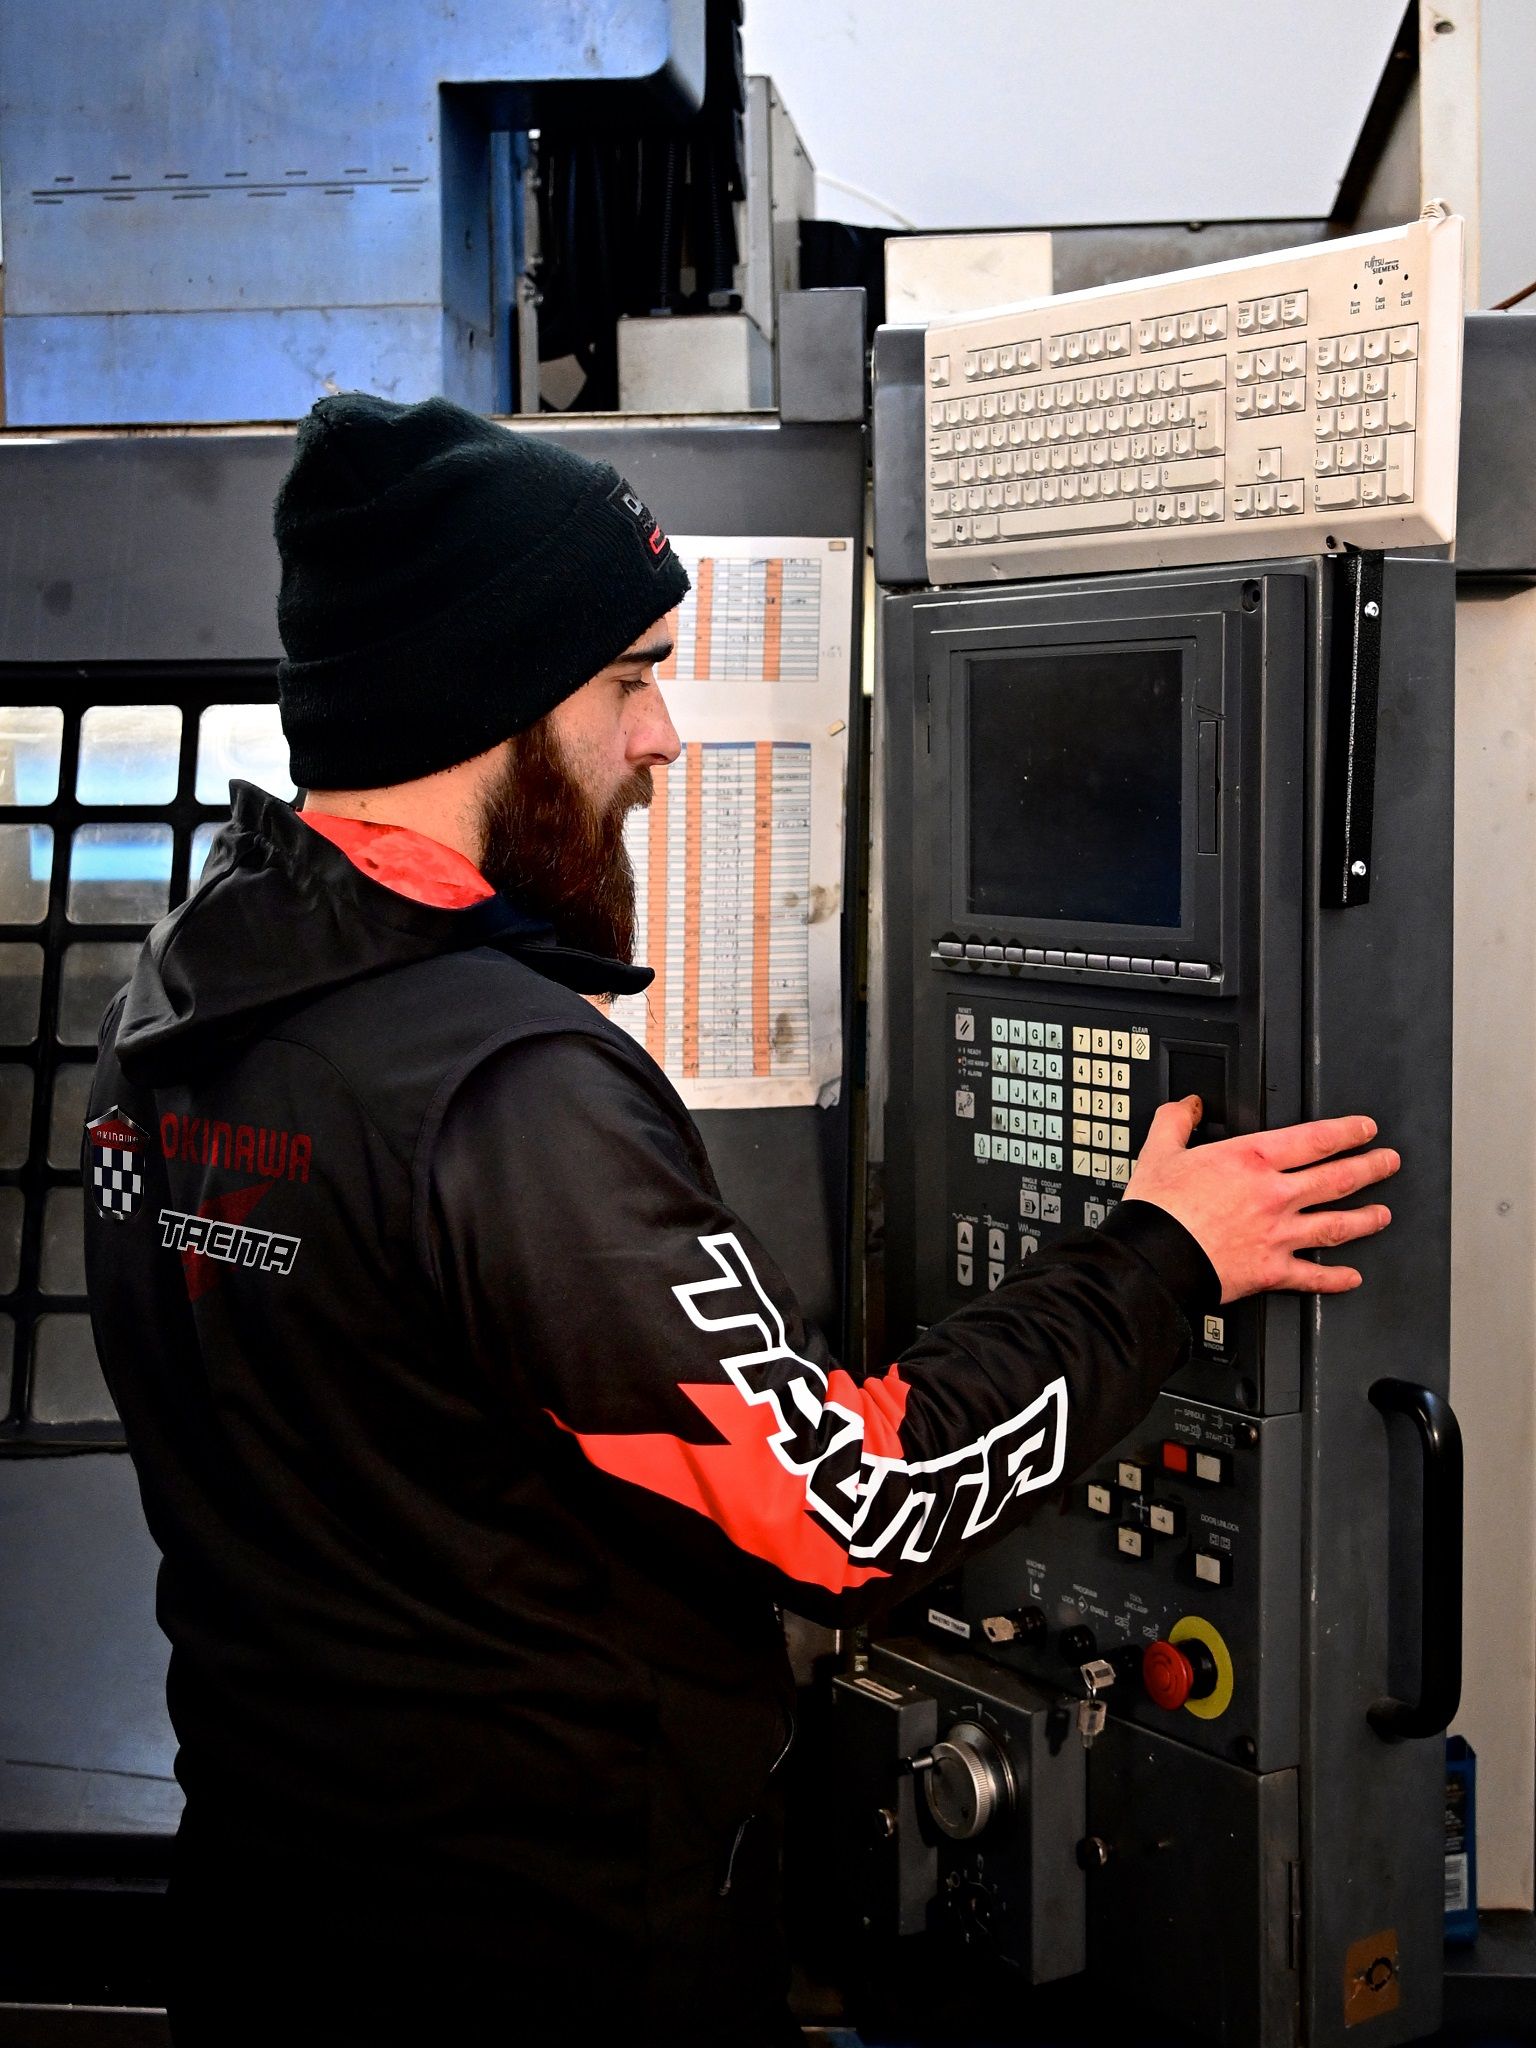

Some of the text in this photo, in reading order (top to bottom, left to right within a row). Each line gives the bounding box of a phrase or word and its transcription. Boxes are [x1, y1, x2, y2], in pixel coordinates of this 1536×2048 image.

[1365, 256, 1384, 269] FUJITSU
[1373, 264, 1399, 274] SIEMENS
[1401, 291, 1412, 299] Scroll
[1317, 380, 1321, 388] 7
[1342, 377, 1346, 385] 8
[1109, 410, 1114, 418] O
[1083, 476, 1089, 484] M
[997, 1025, 1002, 1035] O
[1014, 1027, 1020, 1037] N
[1032, 1029, 1038, 1039] G
[1051, 1031, 1056, 1041] P
[1079, 1035, 1083, 1045] 7
[1098, 1037, 1103, 1047] 8
[1117, 1039, 1123, 1050] 9
[997, 1055, 1002, 1065] X
[1014, 1057, 1020, 1067] Y
[1033, 1060, 1038, 1070] Z
[1051, 1062, 1057, 1072] Q
[1079, 1066, 1083, 1076] 4
[1098, 1068, 1103, 1078] 5
[1118, 1070, 1123, 1081] 6
[999, 1085, 1000, 1094] I
[1015, 1088, 1019, 1097] J
[1033, 1090, 1038, 1100] K
[1051, 1093, 1057, 1103] R
[1079, 1097, 1082, 1106] 1
[1098, 1099, 1103, 1110] 2
[1118, 1102, 1122, 1112] 3
[996, 1114, 1002, 1124] M
[1014, 1117, 1020, 1127] S
[1033, 1120, 1038, 1130] T
[1052, 1123, 1056, 1133] L
[1098, 1130, 1103, 1140] 0
[160, 1111, 313, 1184] OKINAWA
[997, 1144, 1002, 1153] F
[1015, 1147, 1020, 1157] D
[1033, 1150, 1038, 1160] H
[1051, 1153, 1056, 1163] B
[1041, 1179, 1062, 1189] COOLANT
[158, 1208, 302, 1275] TACITA
[1184, 1409, 1206, 1421] SPINDLE
[1175, 1423, 1190, 1432] STOP
[1205, 1432, 1222, 1441] START
[1201, 1514, 1240, 1533] DOOR UNLOCK
